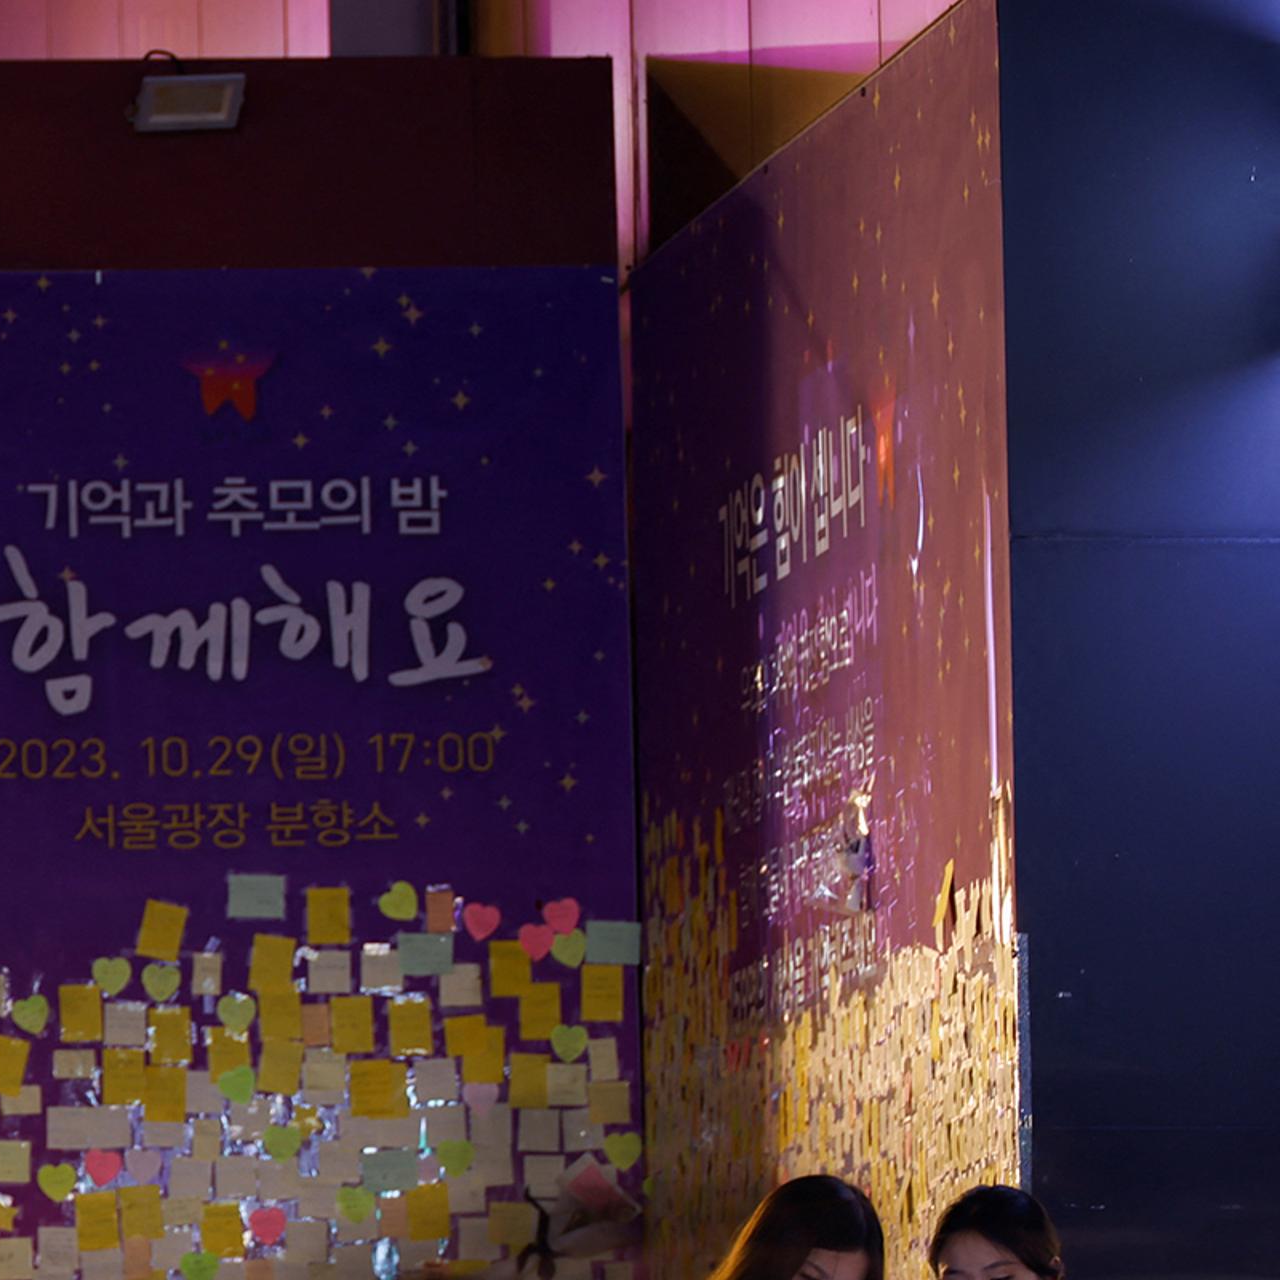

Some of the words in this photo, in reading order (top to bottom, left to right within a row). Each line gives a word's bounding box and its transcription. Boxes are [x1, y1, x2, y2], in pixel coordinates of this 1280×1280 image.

[28, 477, 192, 538] 기억과
[208, 475, 372, 537] 추모의
[391, 475, 447, 536] 밤
[718, 472, 768, 608] 기억은
[772, 442, 807, 581] 힘이
[810, 404, 866, 557] 셉니다
[141, 732, 346, 781] 10.29(일)
[368, 733, 493, 774] 17:00
[74, 801, 248, 851] 서울광장
[267, 801, 398, 849] 분향소
